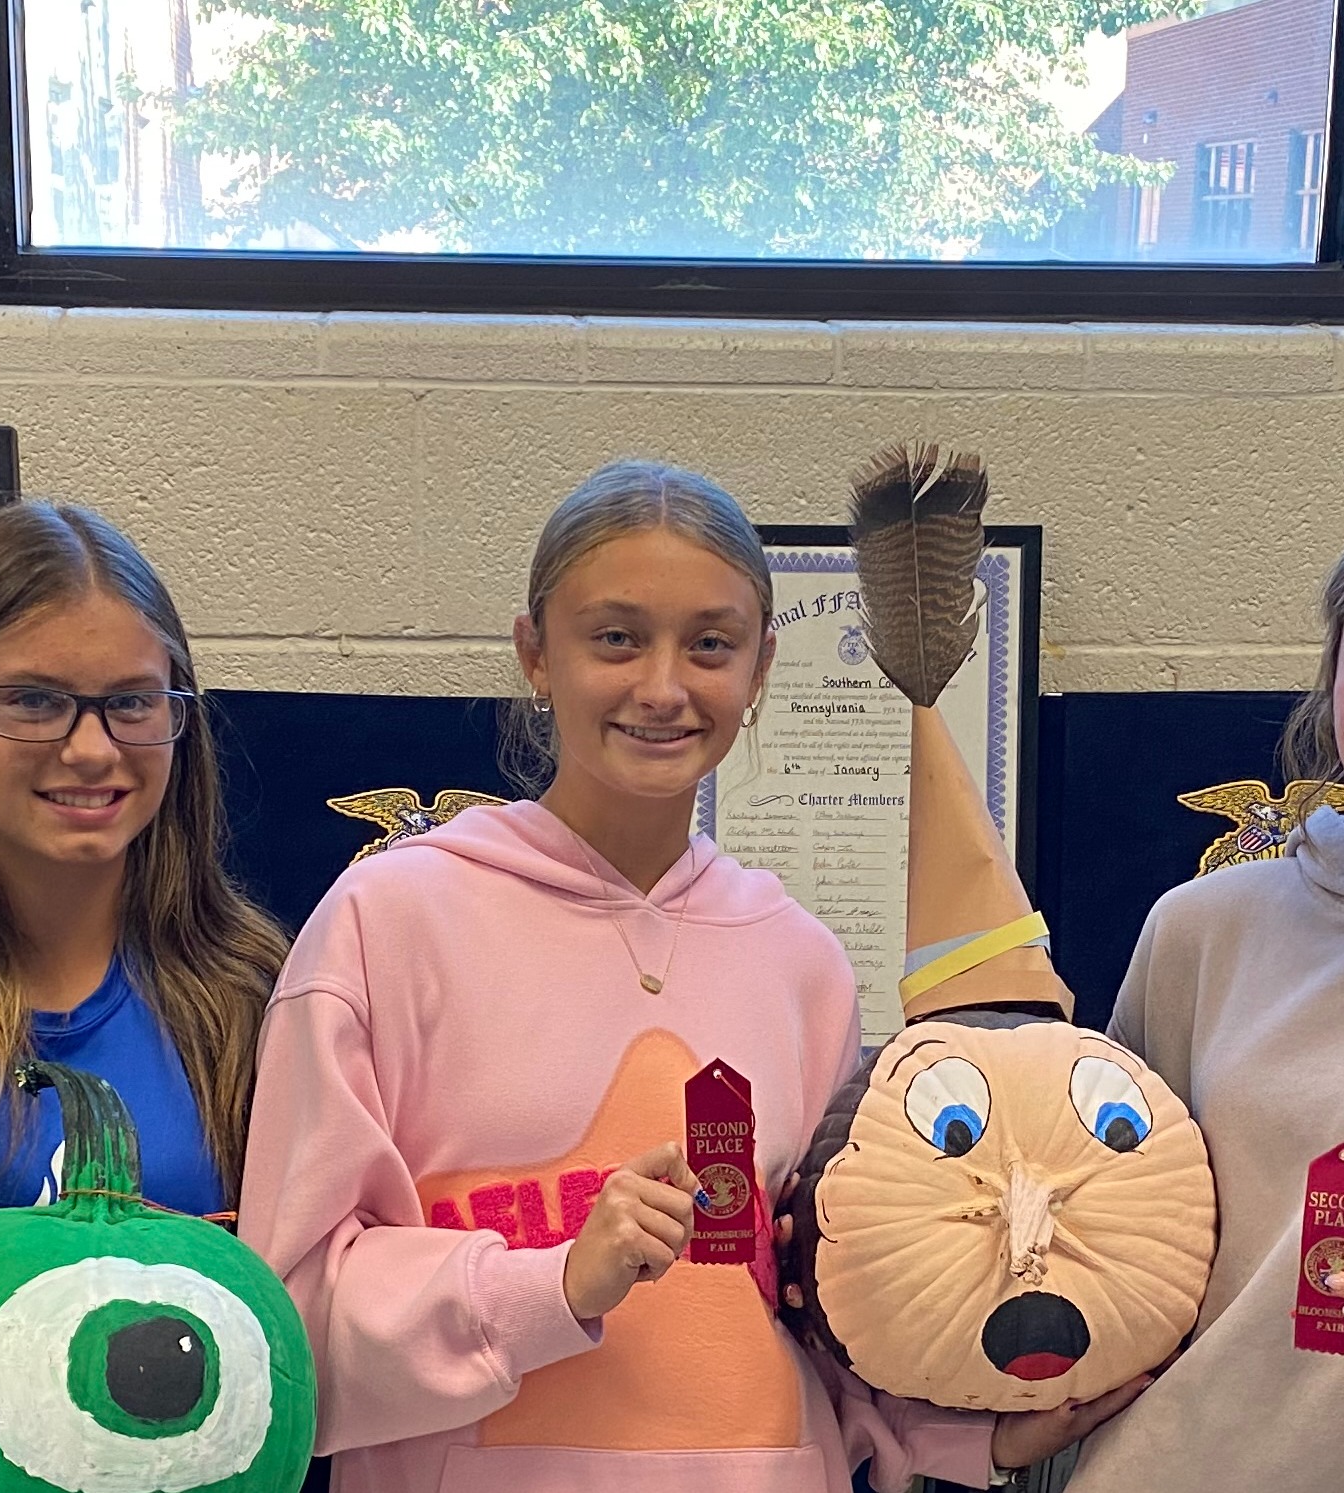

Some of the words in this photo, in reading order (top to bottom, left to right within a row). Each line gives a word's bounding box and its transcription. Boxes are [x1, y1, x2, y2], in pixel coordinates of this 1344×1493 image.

[771, 599, 808, 631] onal
[812, 590, 861, 617] FFA
[822, 675, 871, 689] Southern
[790, 702, 866, 718] Pennsylvania
[784, 763, 801, 774] 6th
[833, 764, 880, 781] January
[798, 793, 844, 807] Charter
[848, 793, 905, 807] Members
[690, 1121, 749, 1138] SECOND
[695, 1138, 744, 1155] PLACE
[709, 1243, 737, 1252] FAIR
[1316, 1321, 1344, 1333] FAIR
